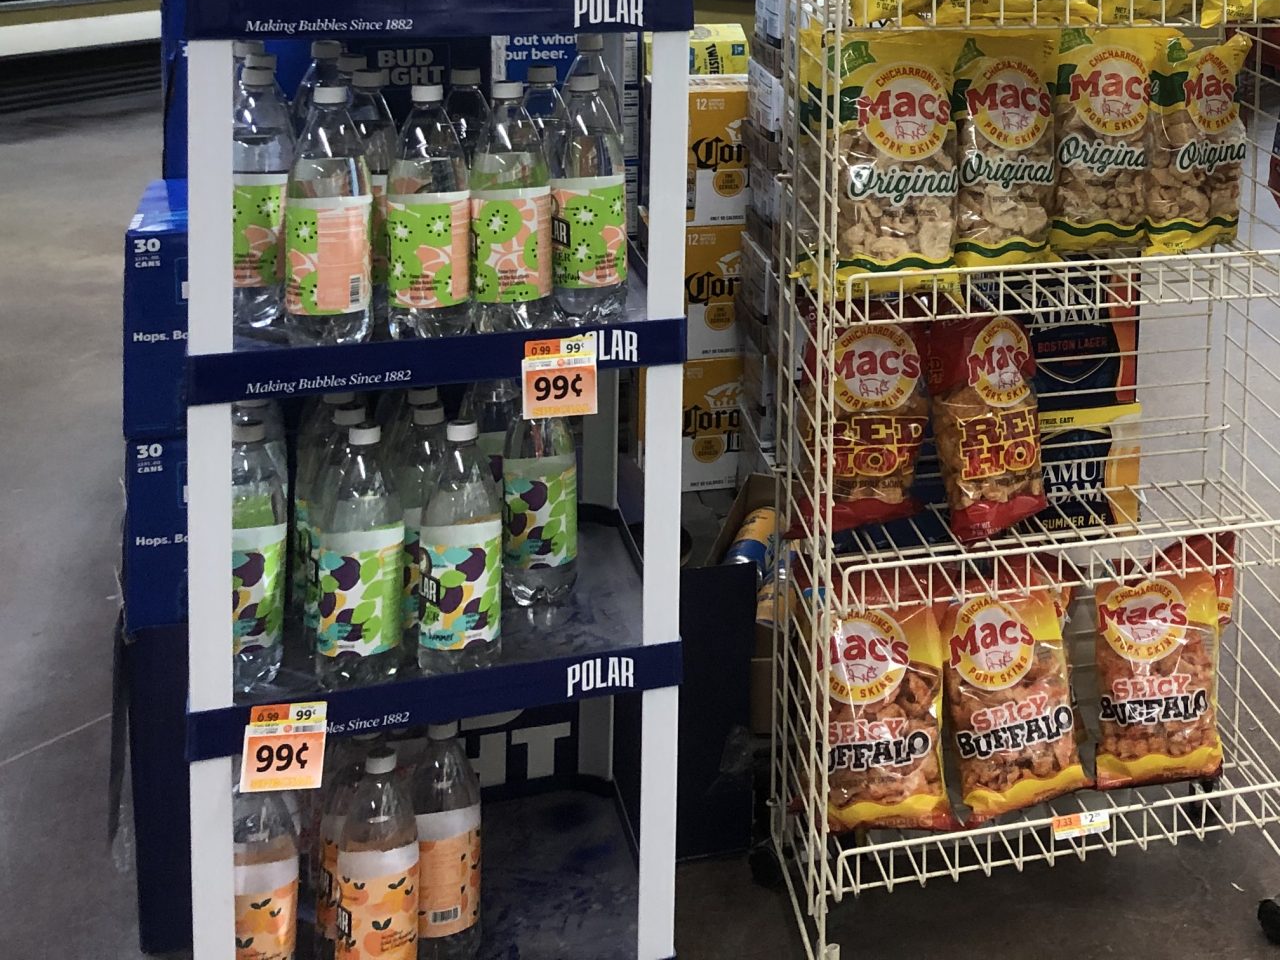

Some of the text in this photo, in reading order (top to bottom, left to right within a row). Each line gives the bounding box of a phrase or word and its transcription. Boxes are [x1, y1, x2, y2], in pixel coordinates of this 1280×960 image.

[245, 18, 413, 35] Making Bubbles Since 1882
[514, 35, 538, 46] out
[377, 48, 434, 67] BUD
[504, 48, 569, 62] our beer.
[705, 42, 718, 75] TWISTE
[383, 66, 445, 86] IGHT
[1069, 70, 1151, 107] Mac's
[695, 98, 707, 110] 12
[857, 89, 951, 128] Mac's
[965, 83, 1051, 118] Mac's
[1083, 106, 1145, 131] PORK SKINS
[875, 131, 940, 155] PORK SKINS
[983, 121, 1041, 145] PORK SKINS
[1059, 136, 1147, 174] Origina
[850, 164, 958, 203] Original
[962, 152, 1055, 190] Original
[134, 238, 161, 253] 30
[134, 259, 161, 268] CANS
[1030, 306, 1102, 336] ADAM
[133, 331, 170, 342] Hops.
[598, 329, 638, 363] LAR
[1037, 338, 1076, 353] BOSTON
[246, 369, 412, 395] Making Bubbles Since 1882
[534, 373, 583, 401] 99¢
[839, 390, 868, 408] PORK
[136, 443, 163, 459] 30
[961, 439, 1037, 480] HO
[137, 464, 163, 473] CANS
[1041, 512, 1107, 530] SUMMER ALE
[135, 534, 172, 547] Hops.
[1099, 599, 1188, 633] Mac's
[566, 656, 635, 698] POLAR
[967, 655, 1028, 685] PORK SKINS
[858, 674, 894, 699] SKINS
[1112, 674, 1191, 700] SPICY
[972, 695, 1049, 732] SPICY
[1100, 690, 1208, 725] BUFFALO
[348, 711, 410, 732] Since 1882
[829, 719, 905, 744] SPICY
[956, 705, 1074, 759] BUFFALO
[255, 743, 310, 773] 99¢
[822, 732, 931, 773] UFFALO
